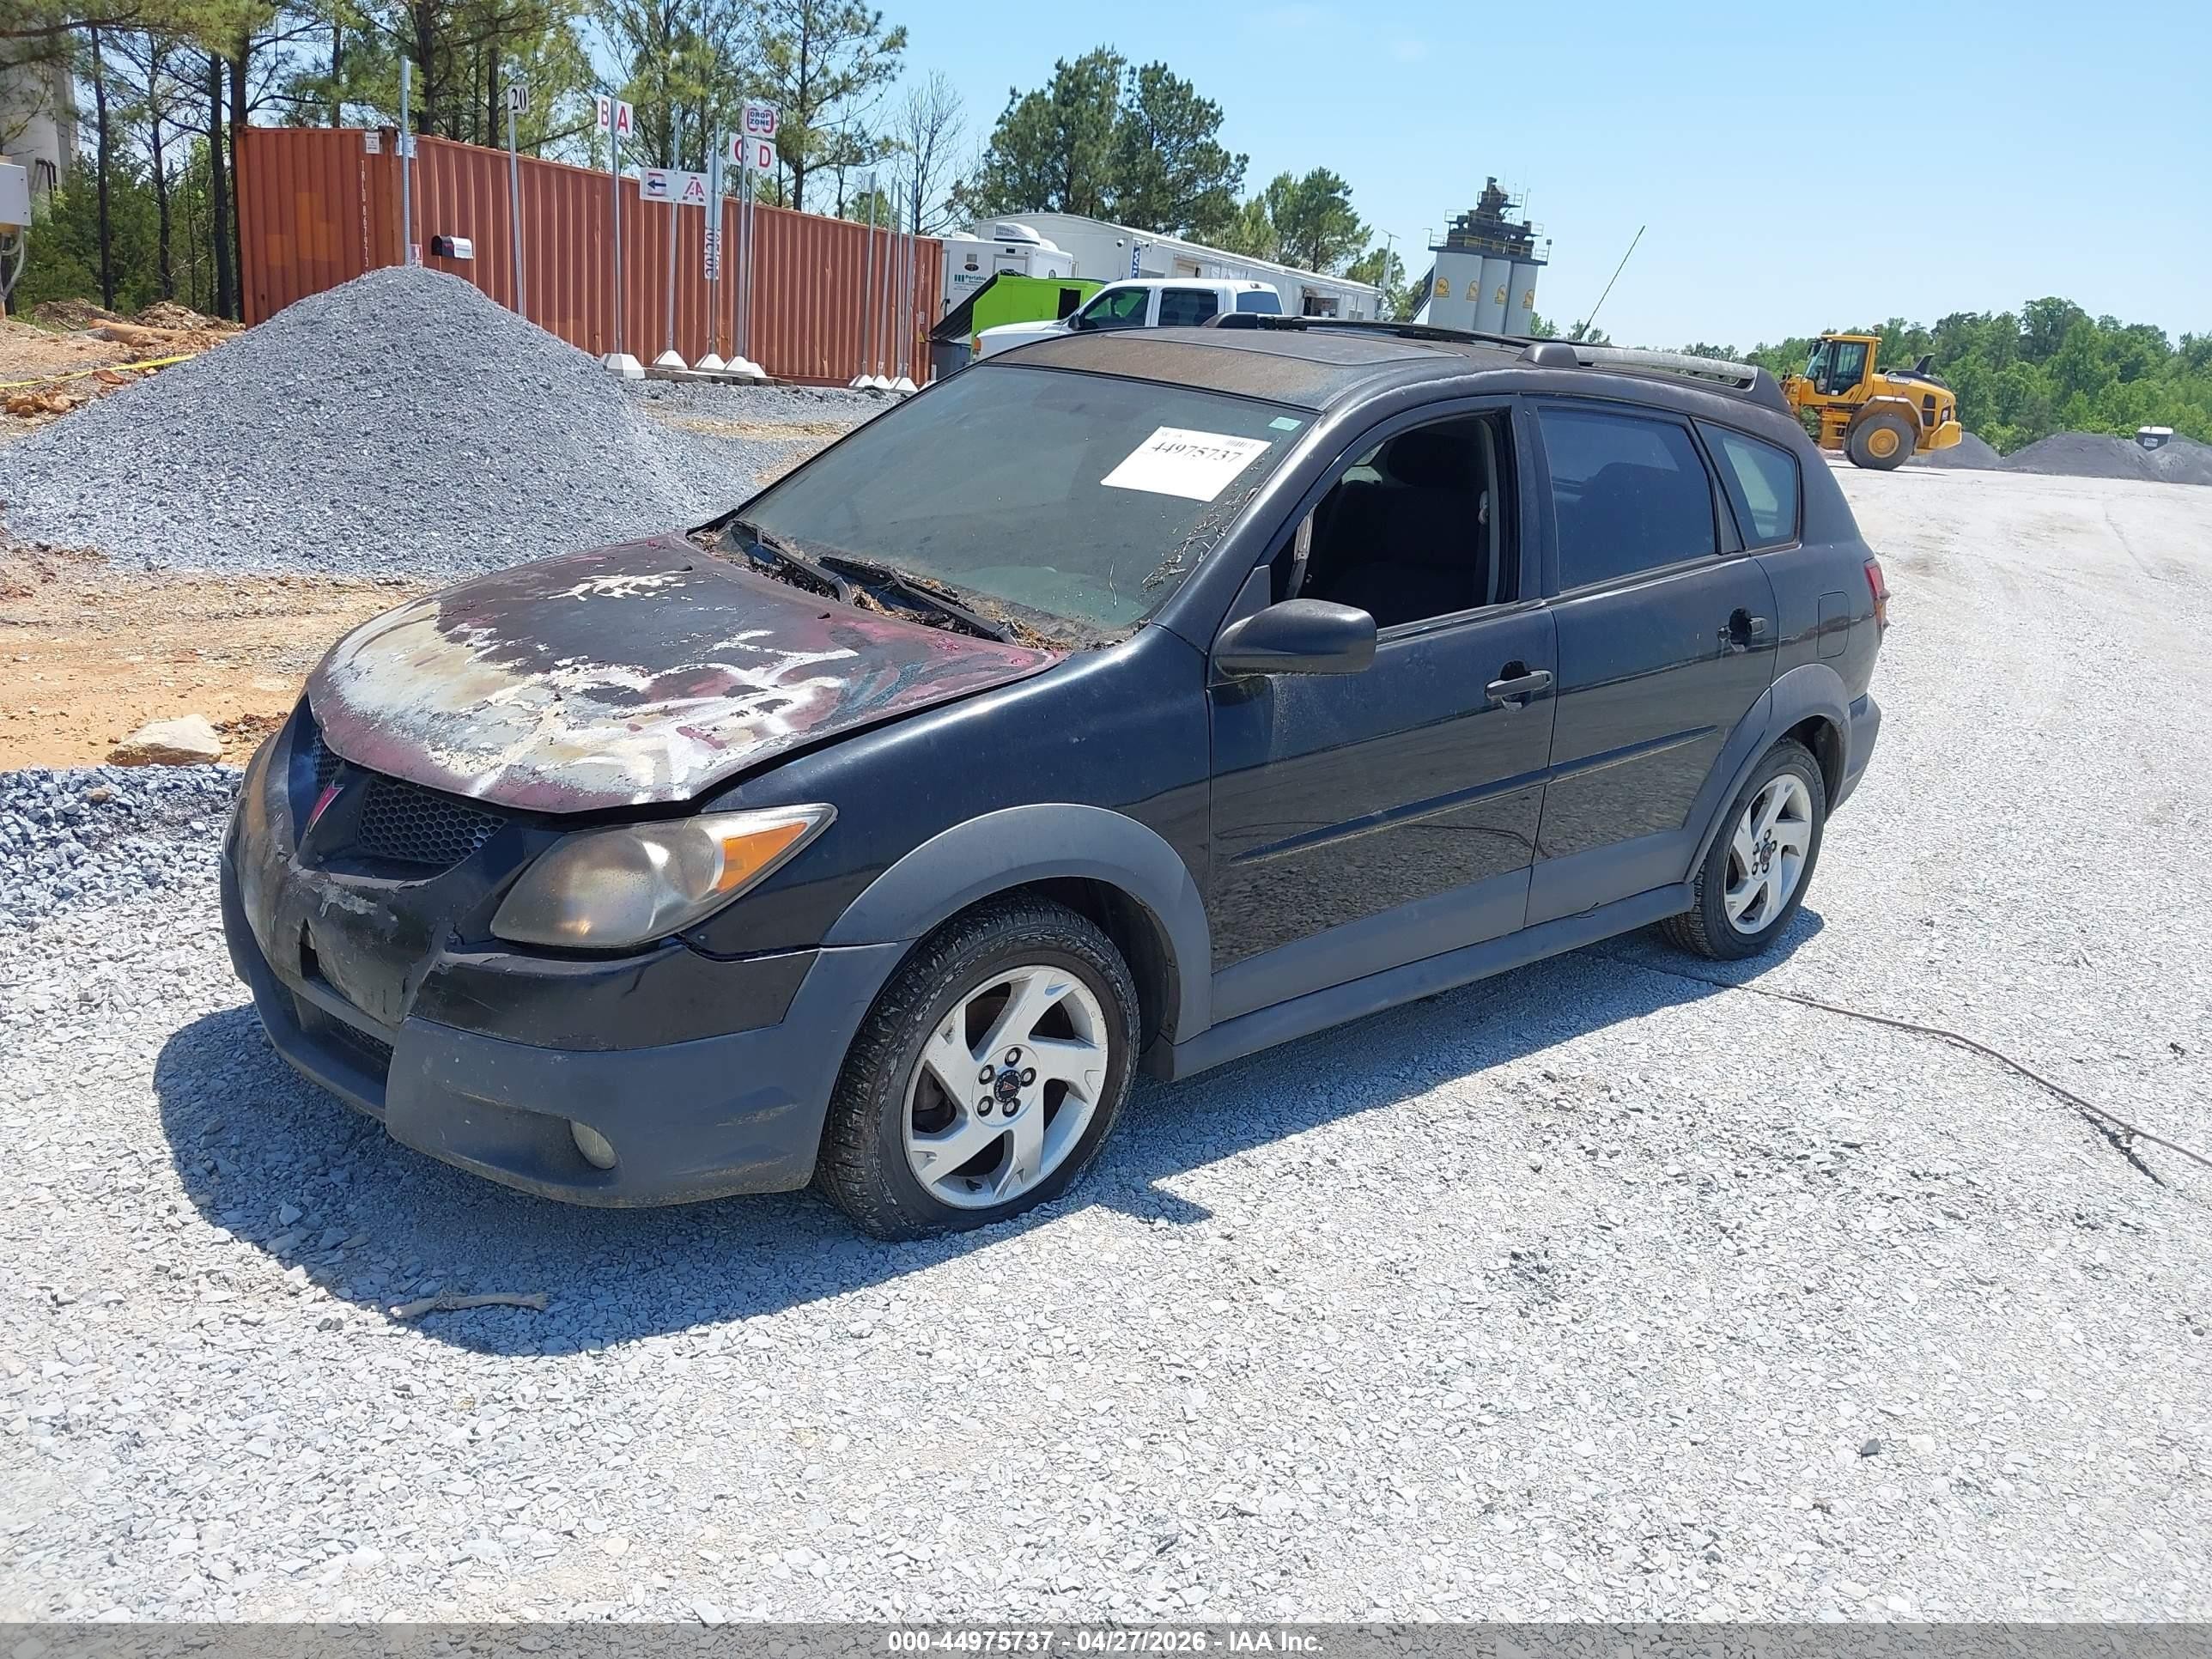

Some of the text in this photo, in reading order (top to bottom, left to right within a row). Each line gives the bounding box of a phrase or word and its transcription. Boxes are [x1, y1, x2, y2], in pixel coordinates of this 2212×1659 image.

[511, 88, 527, 110] 20
[601, 100, 609, 126] B
[617, 106, 629, 133] A
[759, 144, 771, 167] D
[1152, 441, 1243, 463] 44975737
